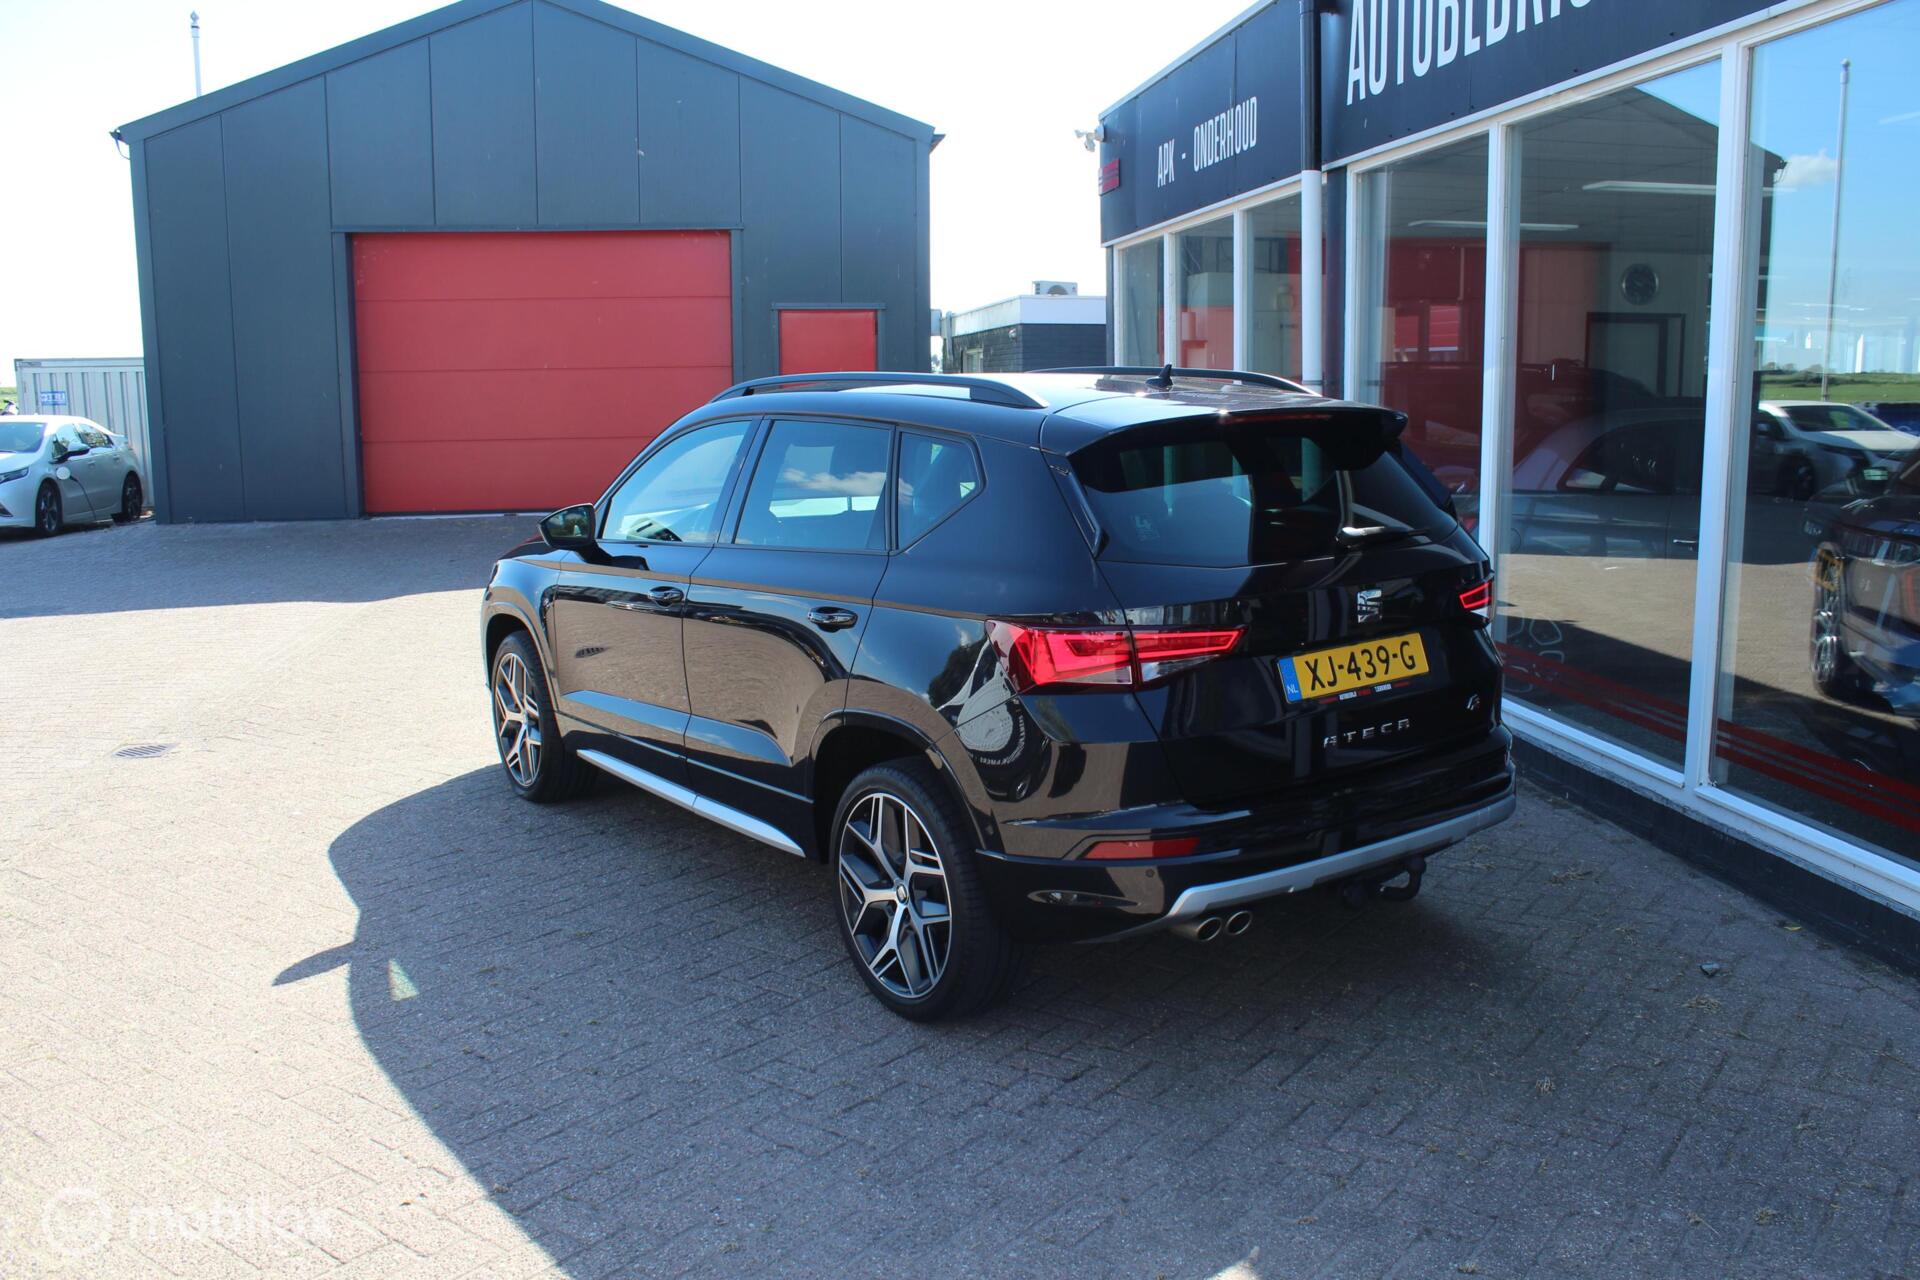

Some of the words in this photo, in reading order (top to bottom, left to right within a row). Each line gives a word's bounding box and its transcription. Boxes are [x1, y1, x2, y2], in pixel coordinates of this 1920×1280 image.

[1157, 138, 1175, 188] APK
[1193, 96, 1258, 172] ONDERHOUD
[1286, 684, 1299, 694] NL
[1304, 641, 1417, 691] XJ-439-G
